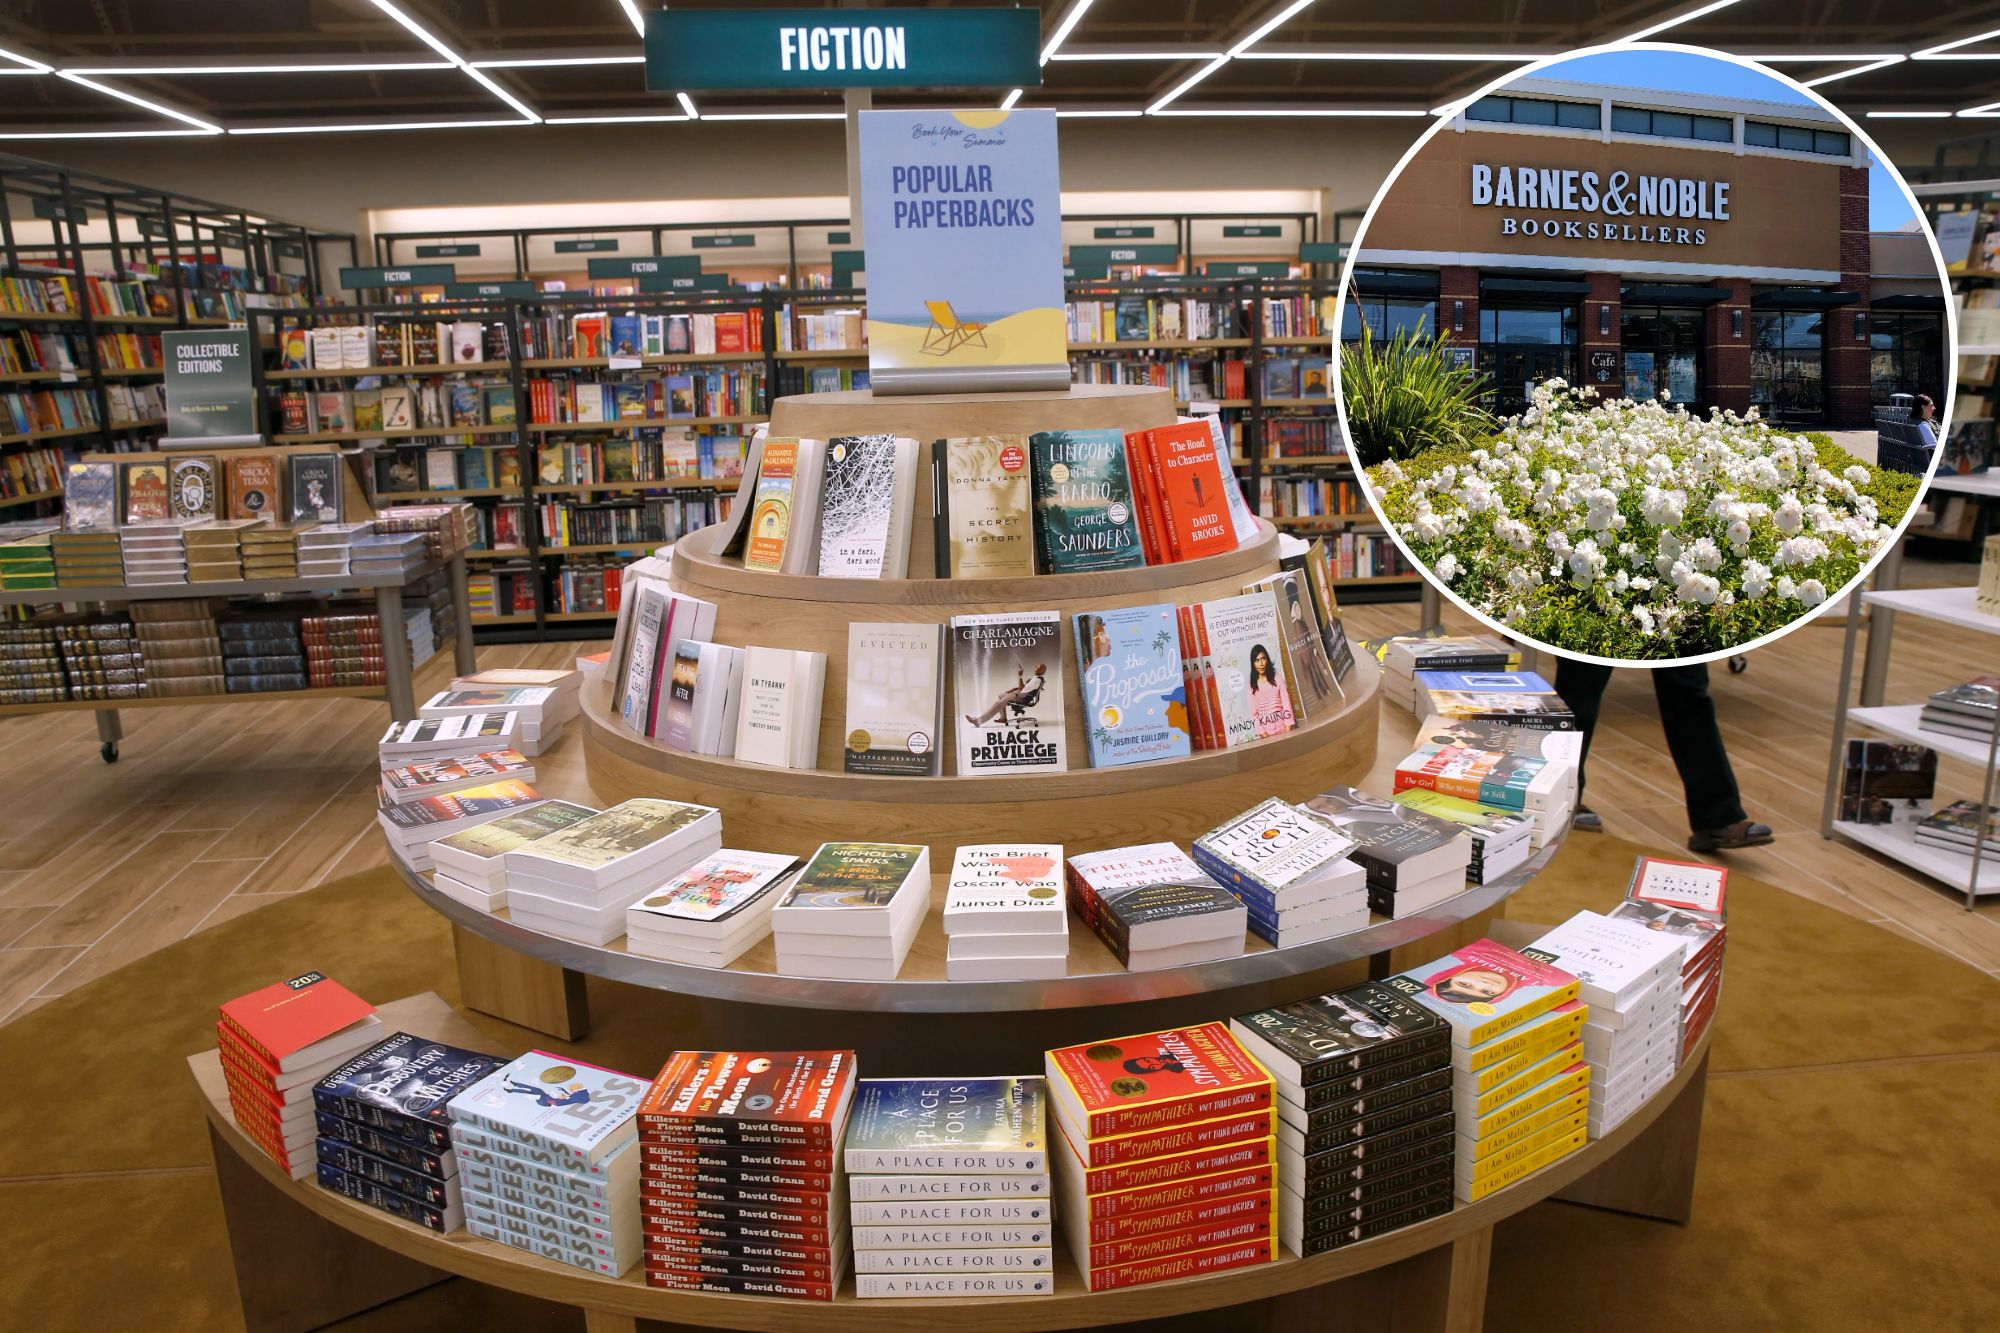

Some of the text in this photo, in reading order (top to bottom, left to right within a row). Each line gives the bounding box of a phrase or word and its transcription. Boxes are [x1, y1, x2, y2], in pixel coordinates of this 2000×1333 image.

[780, 26, 906, 70] FICTION
[912, 124, 963, 140] Book Your
[963, 134, 1008, 148] Summer
[892, 165, 992, 194] POPULAR
[894, 198, 1034, 229] PAPERBACKS
[1503, 218, 1706, 245] BOOKSELLERS
[1111, 250, 1136, 260] FICTION
[631, 263, 657, 272] FICTION
[1237, 266, 1257, 274] FICTION
[384, 272, 411, 282] FICTION
[674, 279, 694, 287] FICTION
[479, 286, 500, 294] FICTION
[177, 344, 239, 358] COLLECTIBLE
[178, 360, 222, 374] EDITIONS
[1592, 357, 1615, 367] Café
[1050, 443, 1115, 462] LINCOLN
[1170, 438, 1206, 453] The Road
[1168, 454, 1214, 468] to Character
[239, 467, 270, 477] NIKOLA
[1070, 467, 1096, 478] IN THE
[243, 475, 268, 486] TESLA
[1062, 482, 1110, 502] BARDO
[1075, 513, 1107, 528] GEORGE
[1192, 514, 1218, 527] DAVID
[1059, 529, 1131, 552] SAUNDERS
[1192, 525, 1225, 542] BROOKS
[1216, 615, 1244, 628] EVERYONE
[1245, 610, 1274, 621] HANGING
[963, 627, 1054, 640] CHARLAMAGNE
[1217, 629, 1229, 637] OUT
[1231, 623, 1257, 634] WITHOUT
[860, 640, 927, 649] EVICTED
[982, 637, 1036, 648] THA GOD
[1124, 653, 1149, 670] the
[761, 679, 786, 689] TYRANNY
[1084, 648, 1181, 710] Proposal
[676, 687, 688, 700] AFTER
[1229, 719, 1256, 734] MINDY
[986, 730, 1040, 745] BLACK
[1113, 736, 1139, 747] JASMINE
[971, 743, 1057, 760] PRIVILEGE
[1404, 776, 1419, 785] The
[1419, 778, 1434, 788] Girl
[1491, 789, 1506, 800] Silk
[1218, 807, 1286, 846] THINK
[1361, 815, 1428, 848] WITCHES
[1248, 826, 1310, 863] RICH
[832, 850, 908, 859] NICHOLAS
[840, 856, 889, 865] SPARKS
[1087, 856, 1183, 874] THE MAN
[1121, 875, 1182, 887] TRAIN
[1177, 901, 1214, 911] JAMES
[1466, 954, 1508, 976] Malala
[1487, 1024, 1498, 1034] Am
[1501, 1014, 1523, 1027] Malala
[324, 1035, 413, 1089] DEBORAH HARKNESS
[1157, 1031, 1221, 1087] SYMPATHIZER
[365, 1049, 449, 1096] DISCOVERY
[427, 1066, 451, 1076] OF
[415, 1061, 482, 1102] WITCHES
[699, 1055, 739, 1112] the Flower
[809, 1053, 843, 1118] David Grann
[670, 1068, 709, 1113] Killers
[717, 1077, 752, 1115] Moon
[544, 1077, 643, 1138] LESS
[891, 1108, 909, 1118] A
[916, 1089, 939, 1139] PLACE
[945, 1086, 968, 1142] FOR US
[995, 1097, 1006, 1126] FATIMA
[1120, 1113, 1133, 1121] THE
[1132, 1103, 1194, 1127] SYMPATHIZER
[1199, 1102, 1213, 1112] VIET
[1232, 1093, 1255, 1106] NGUYEN
[645, 1115, 680, 1123] Killers
[657, 1123, 804, 1133] Flower Moon David Grann
[876, 1157, 1015, 1167] A PLACE FOR US
[653, 1236, 687, 1245] Killers
[665, 1245, 806, 1258] Flower Moon David Grann
[886, 1256, 1022, 1266] A PLACE FOR US
